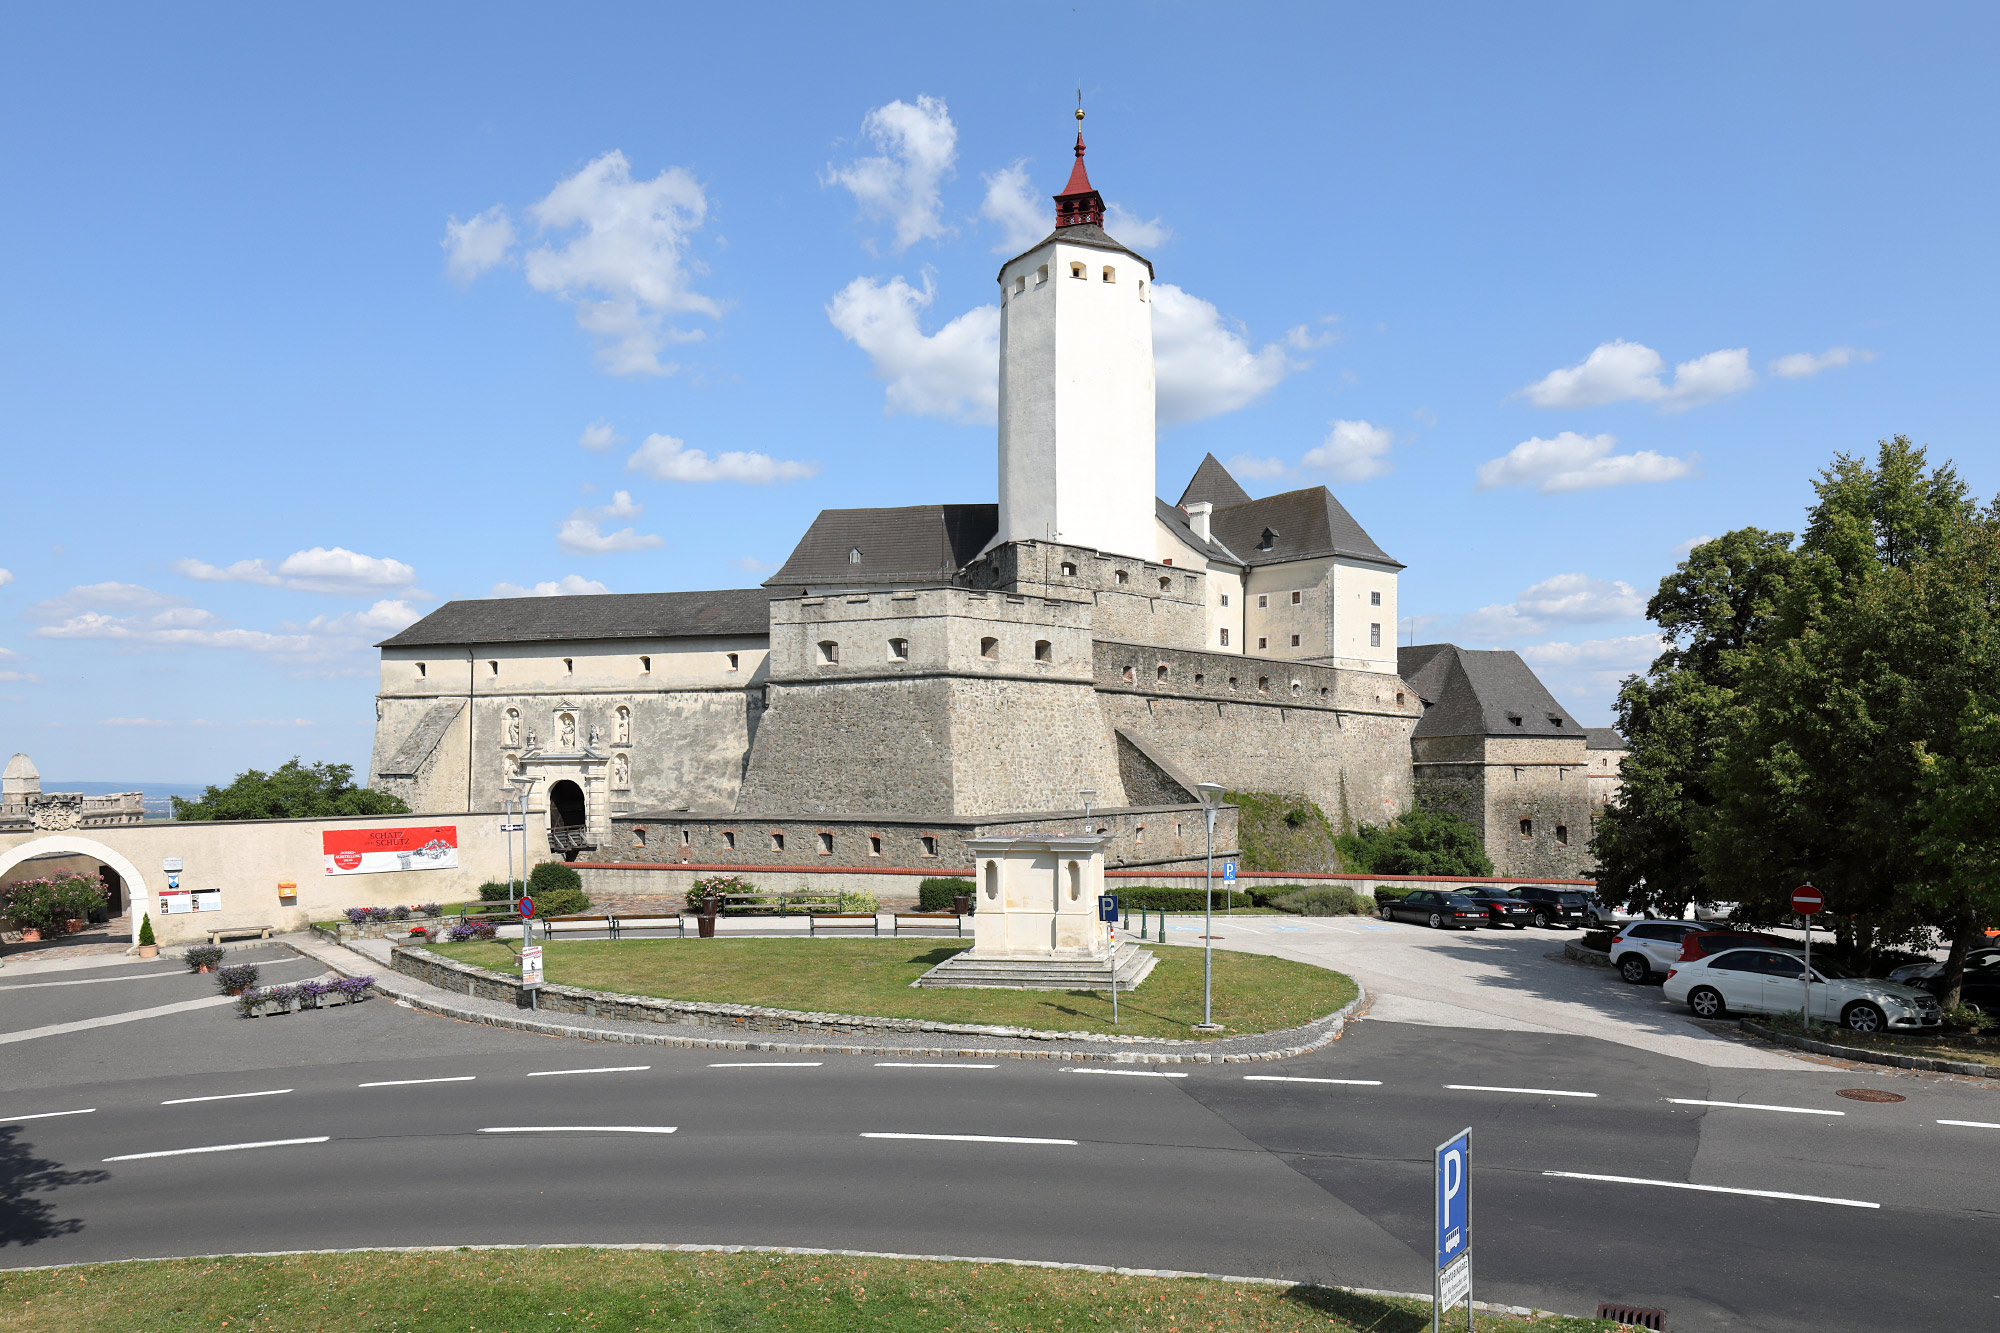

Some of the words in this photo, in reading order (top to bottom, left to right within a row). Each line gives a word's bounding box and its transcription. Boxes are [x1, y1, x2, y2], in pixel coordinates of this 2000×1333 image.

[376, 838, 409, 846] SCHUTZ
[1226, 863, 1233, 876] P
[1102, 897, 1114, 921] P
[1444, 1149, 1461, 1230] P
[1441, 1260, 1467, 1287] Privatparkplatz
